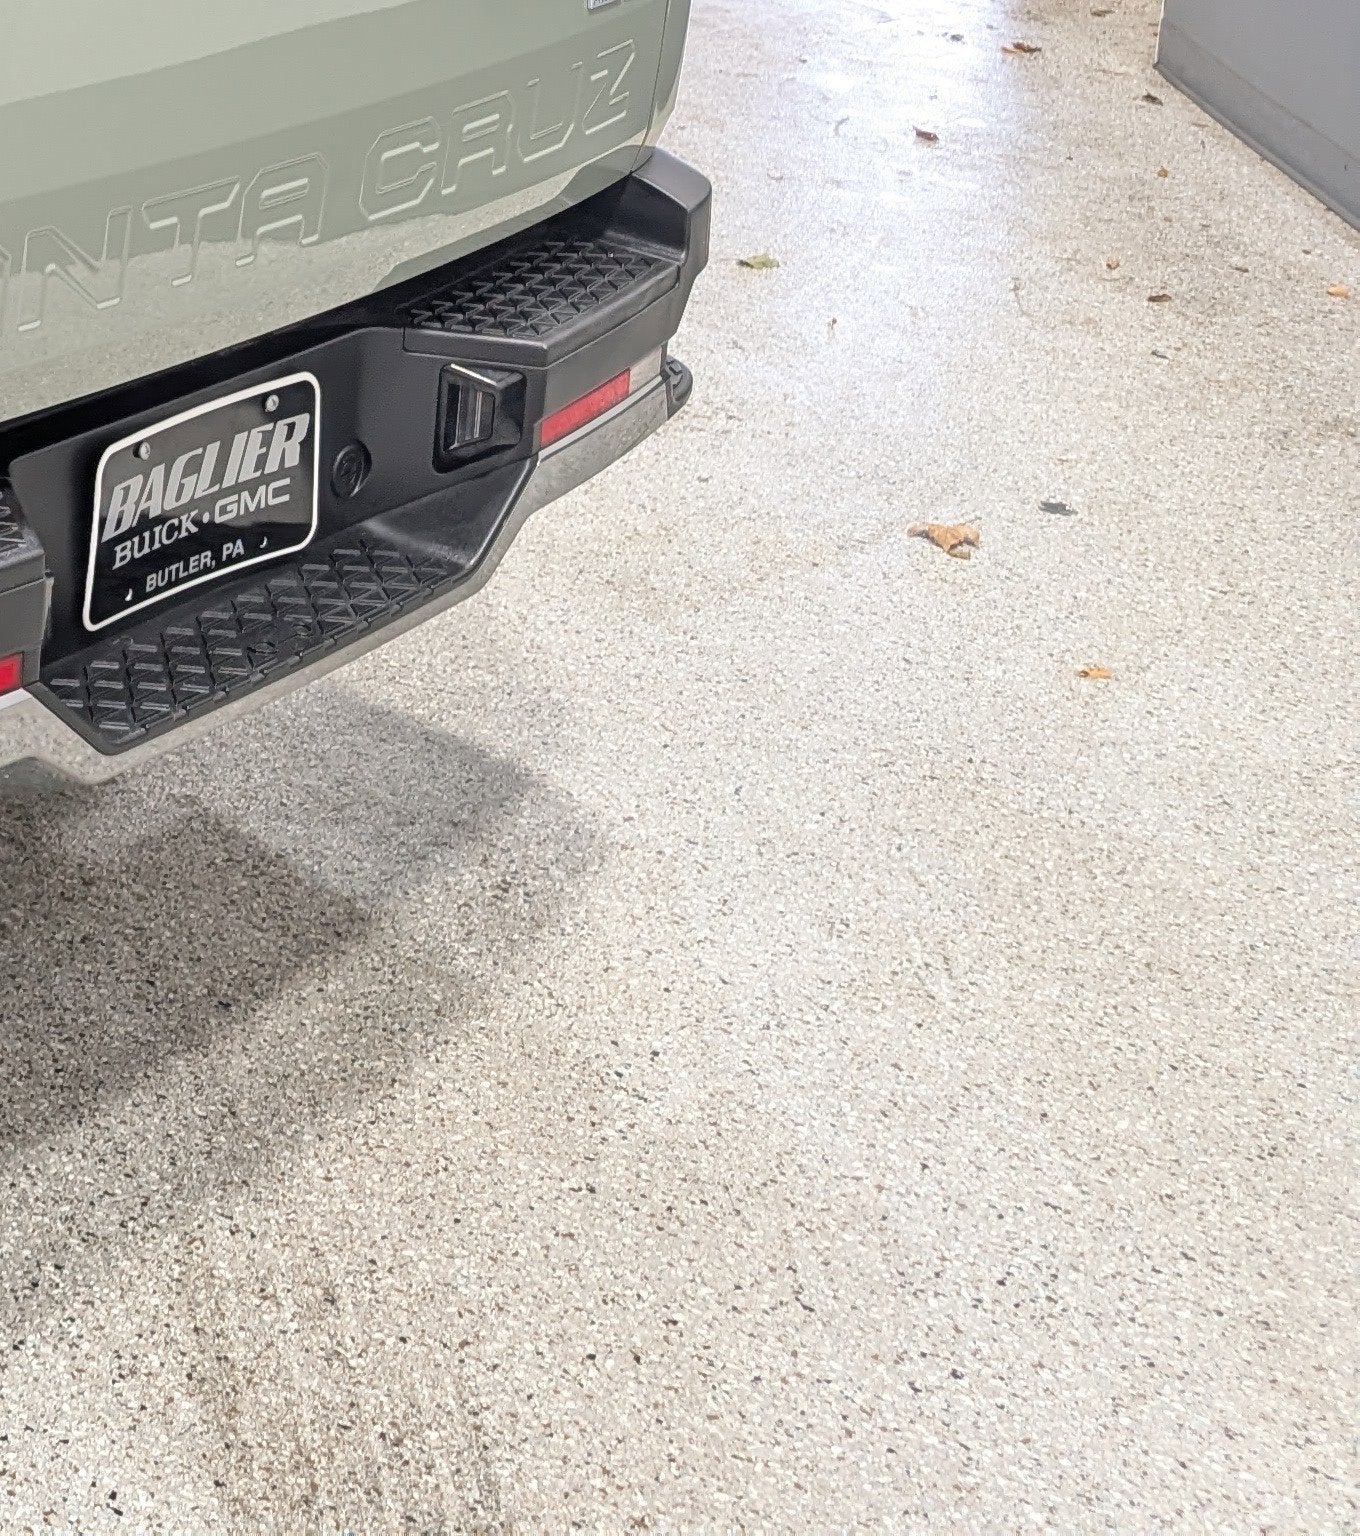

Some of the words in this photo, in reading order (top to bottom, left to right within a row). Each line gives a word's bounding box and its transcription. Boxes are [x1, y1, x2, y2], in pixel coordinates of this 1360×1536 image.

[359, 38, 637, 222] CRUZ
[101, 412, 311, 544] BAGLIER
[145, 550, 216, 593] BUTLER,
[222, 539, 245, 562] PA
